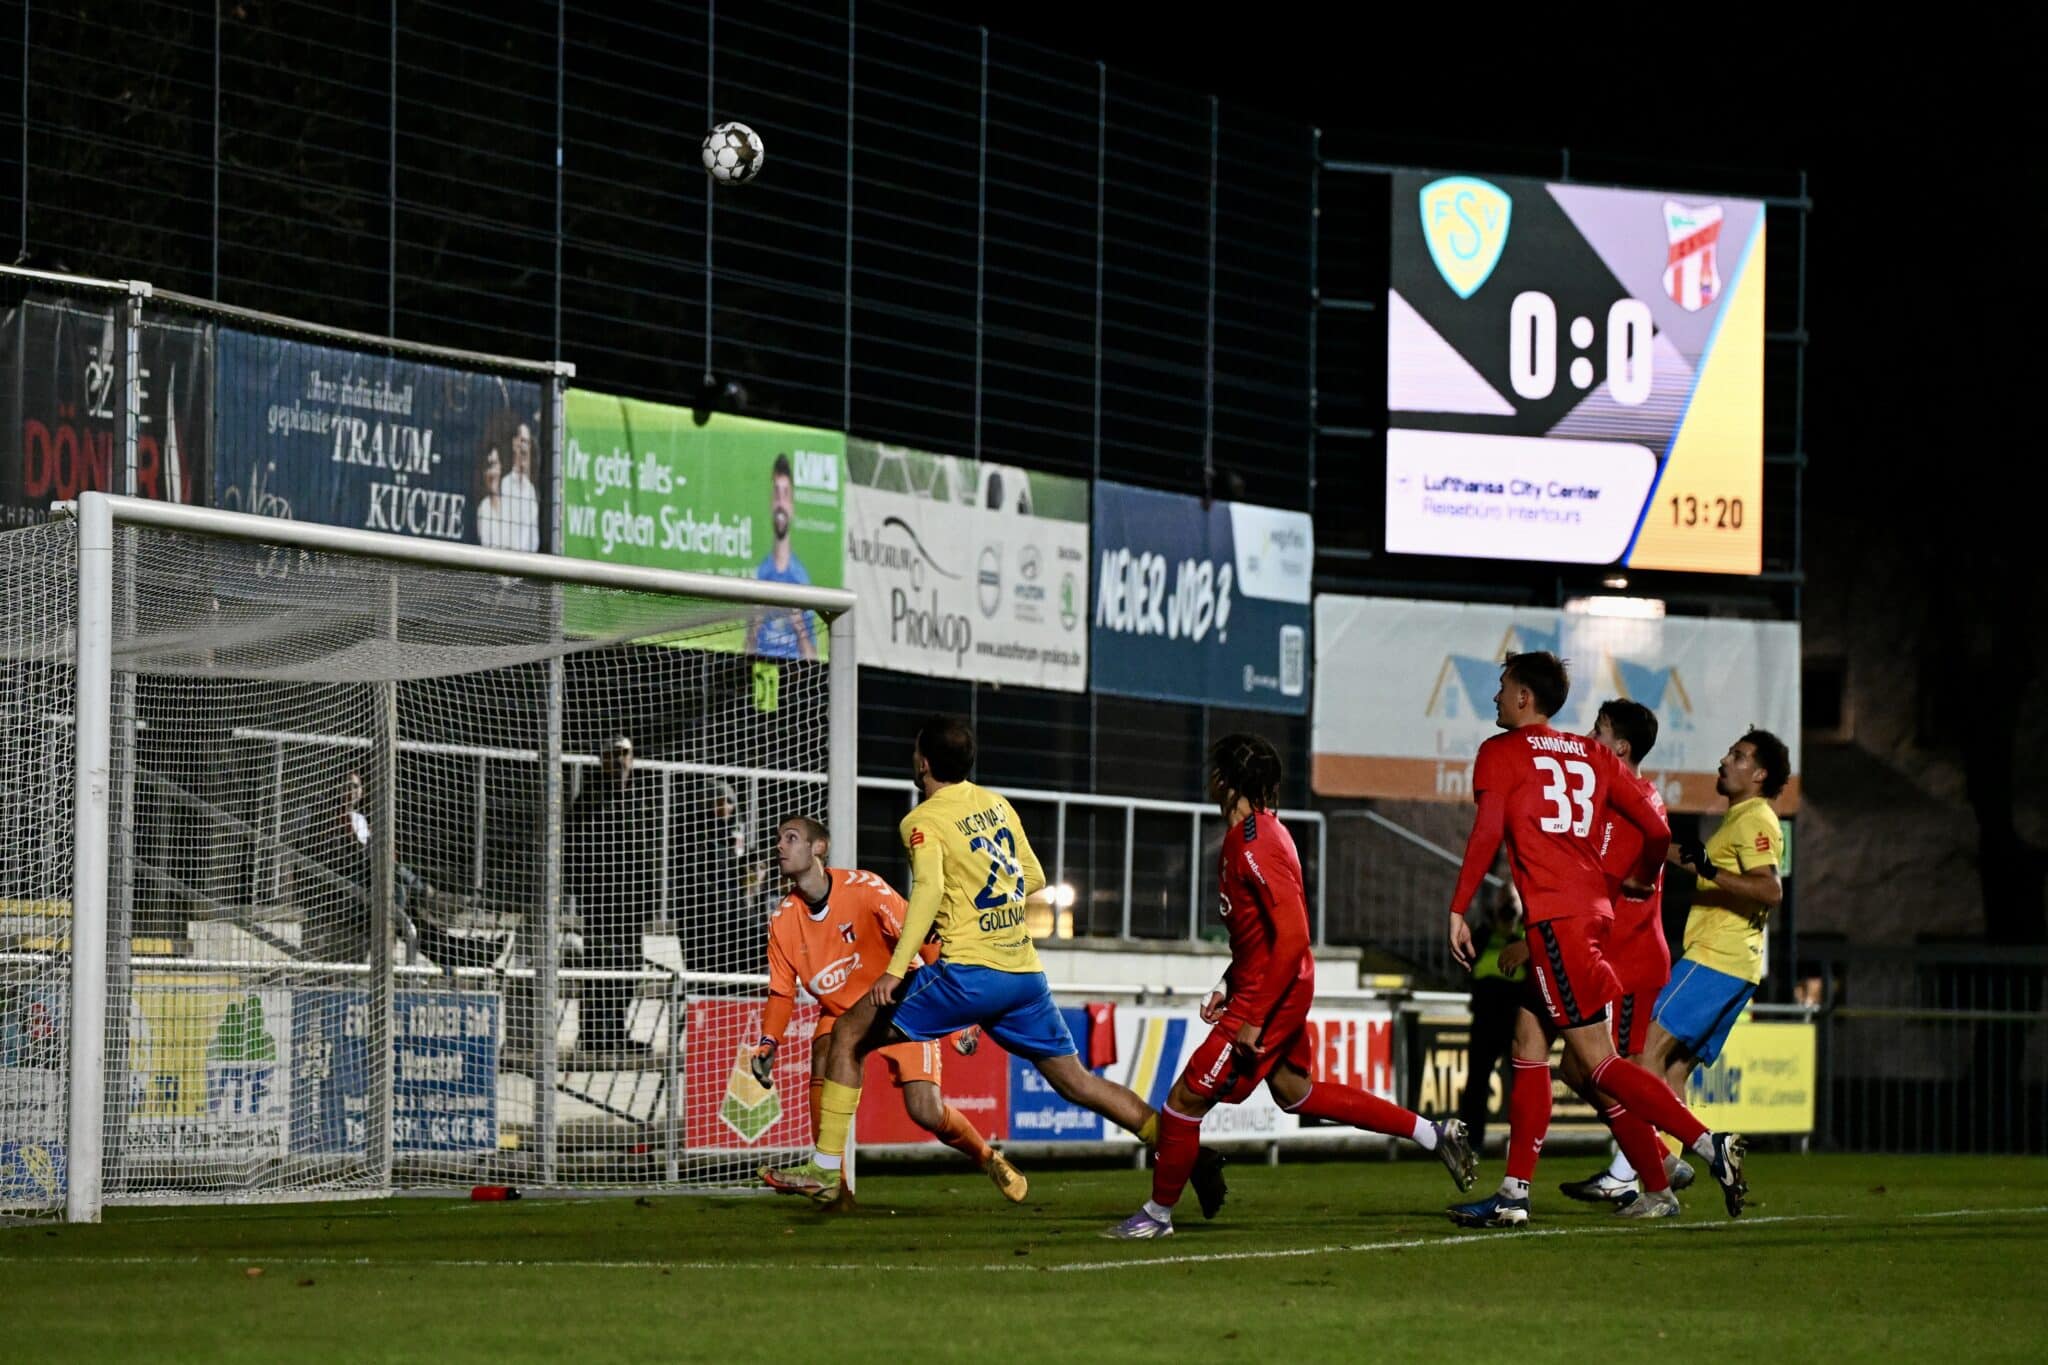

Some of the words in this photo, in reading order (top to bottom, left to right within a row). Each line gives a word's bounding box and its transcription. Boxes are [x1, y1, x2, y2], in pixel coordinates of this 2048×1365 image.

[307, 370, 337, 402] Ihre
[268, 400, 330, 436] geplante
[331, 414, 442, 475] TRAUM-
[594, 447, 632, 496] gebt
[638, 452, 673, 494] alles
[1423, 474, 1504, 494] Lufthansa
[1509, 478, 1541, 500] City
[1547, 480, 1600, 499] Center
[366, 474, 466, 539] KÜCHE
[602, 502, 655, 554] geben
[659, 505, 753, 559] Sicherheit!
[1671, 496, 1743, 529] 13:20
[891, 587, 972, 668] Prokop
[1526, 735, 1588, 758] SCHMÖKEL
[1532, 756, 1597, 838] 33
